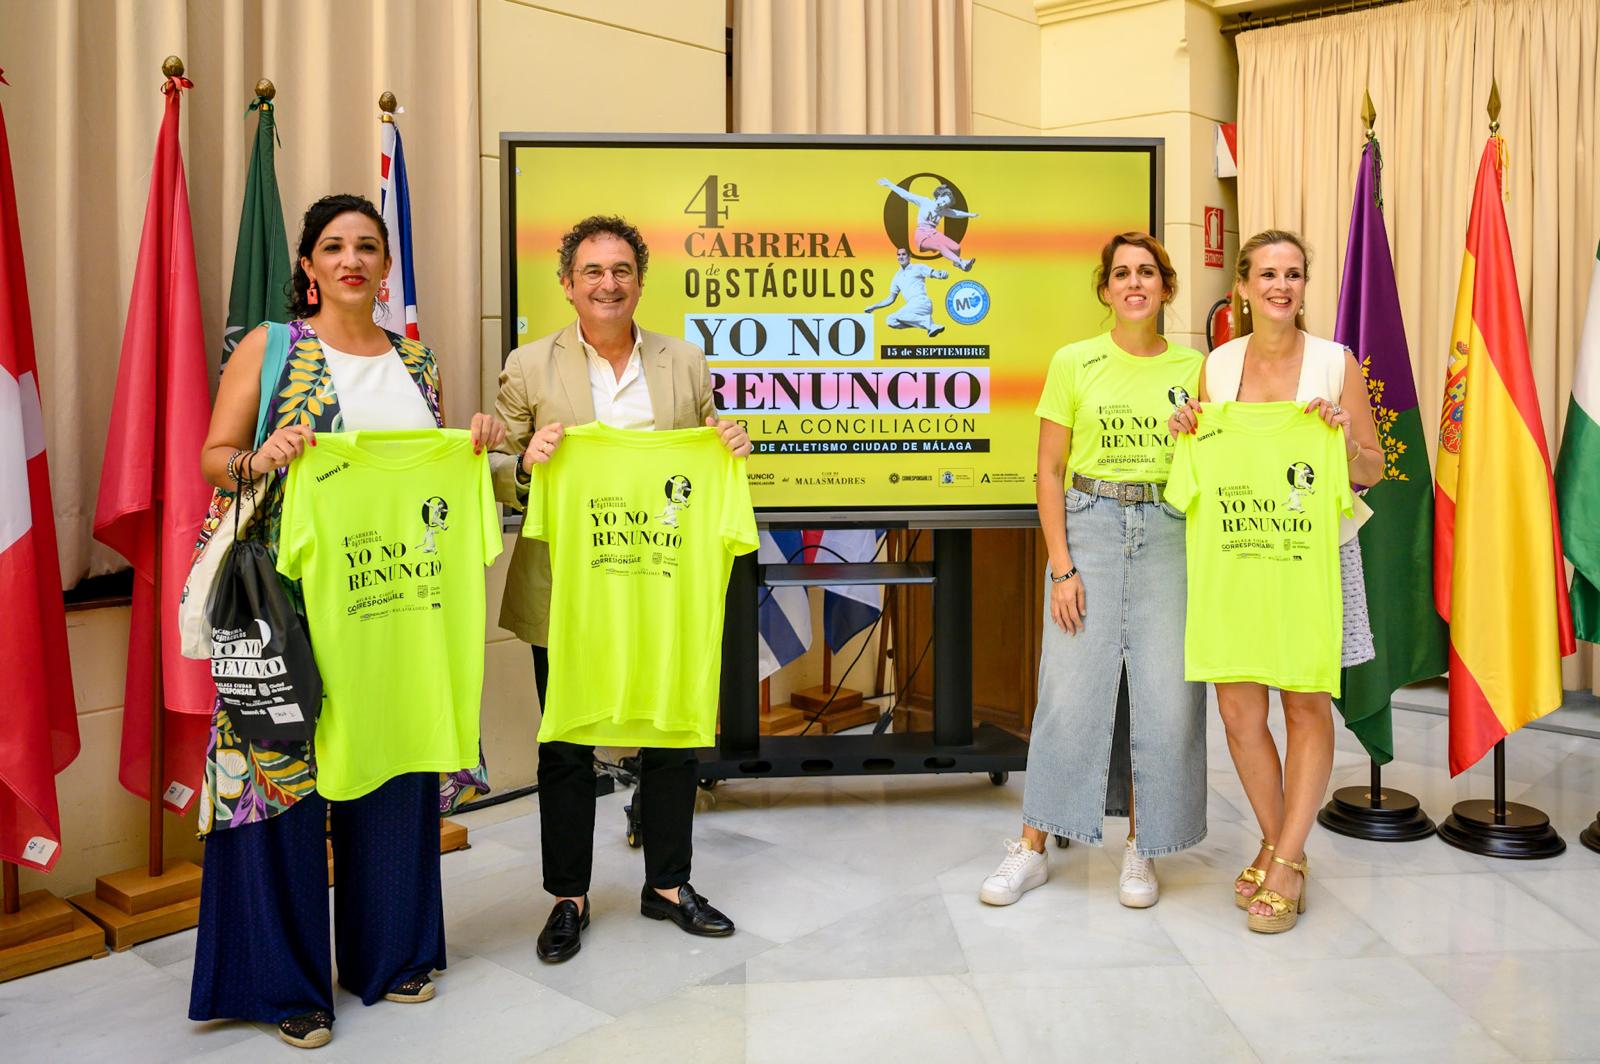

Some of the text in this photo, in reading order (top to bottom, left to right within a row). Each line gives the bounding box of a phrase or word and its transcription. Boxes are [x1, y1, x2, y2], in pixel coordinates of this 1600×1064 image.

[684, 232, 856, 259] CARRERA
[685, 263, 876, 308] OBSTÁCULOS
[690, 317, 867, 357] YO NO
[887, 347, 986, 357] 15 de SEPTIEMBRE
[762, 419, 789, 435] LA
[800, 414, 976, 434] CONCILIACIÓN
[1099, 416, 1158, 431] YO NO
[760, 443, 776, 453] DE
[780, 442, 848, 452] ATLETISMO
[852, 442, 898, 452] CIUDAD
[902, 442, 918, 452] DE
[923, 439, 973, 452] MÁLAGA
[316, 465, 341, 483] luanvi
[1219, 498, 1276, 514] YO NO
[591, 511, 648, 527] YO NO
[1221, 517, 1312, 533] RENUNCIO
[592, 530, 682, 549] RENUNCIO
[346, 542, 407, 569] YO NO
[347, 559, 442, 592] RENUNCIO
[243, 641, 260, 656] NO
